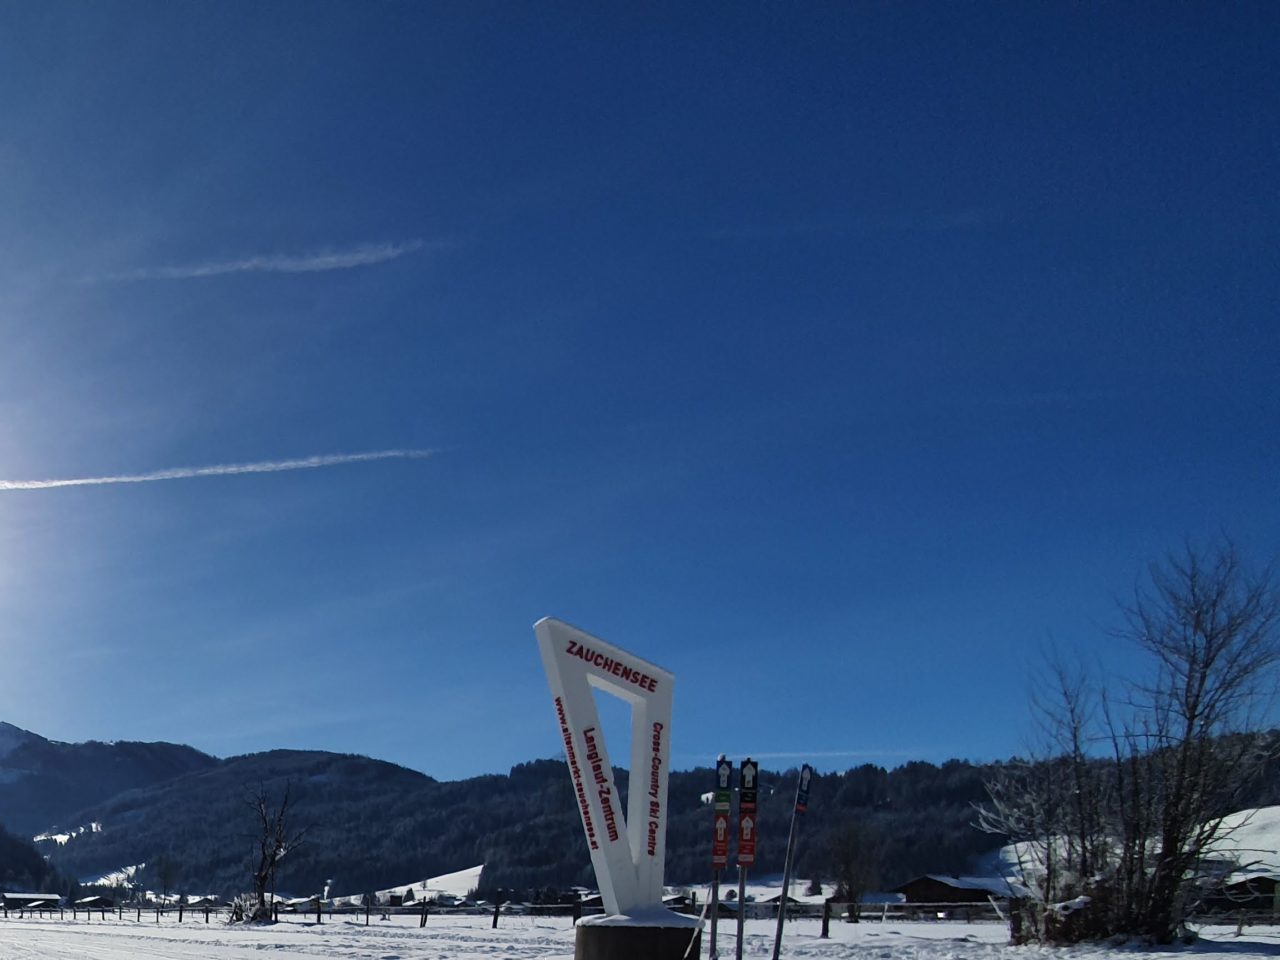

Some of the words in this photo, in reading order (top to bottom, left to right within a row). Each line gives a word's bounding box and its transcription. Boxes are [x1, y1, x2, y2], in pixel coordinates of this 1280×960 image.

[566, 640, 658, 693] ZAUCHENSEE
[554, 696, 599, 851] www.altenmarkt-zauchensee.at
[582, 727, 619, 842] Langlauf-Zentrum
[648, 722, 664, 799] Cross-Country
[647, 820, 659, 857] Centre
[649, 800, 660, 819] Ski
